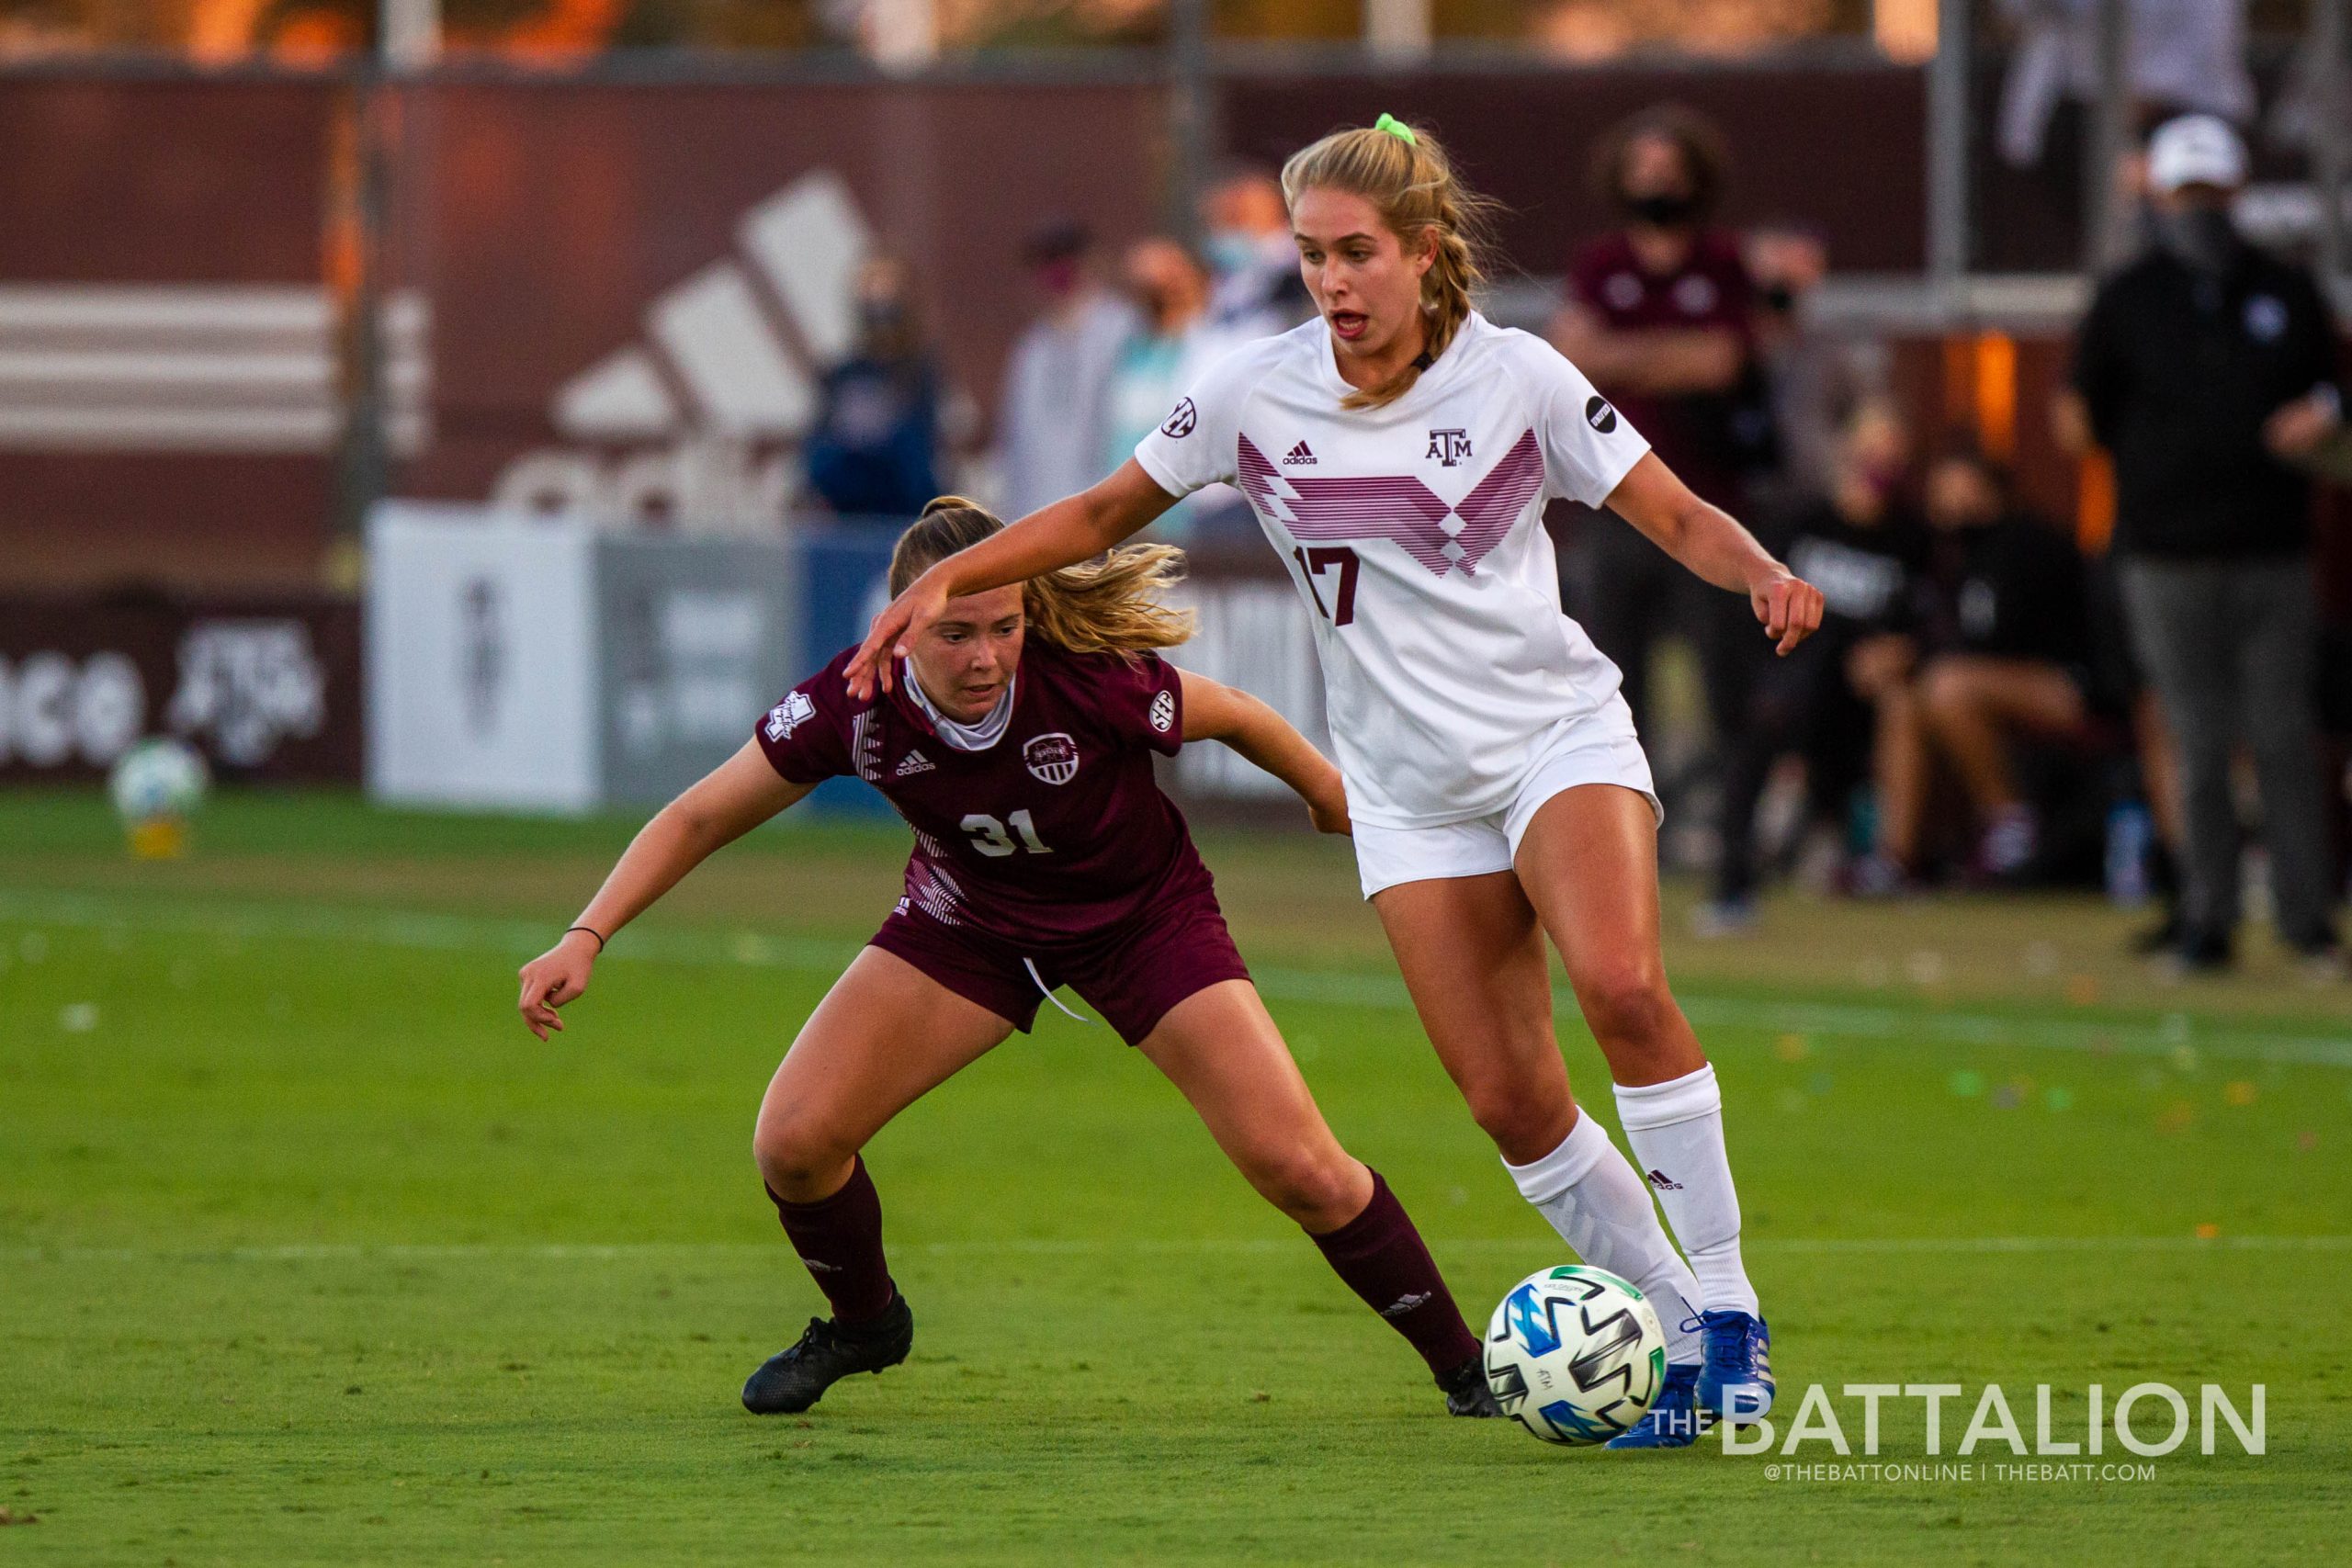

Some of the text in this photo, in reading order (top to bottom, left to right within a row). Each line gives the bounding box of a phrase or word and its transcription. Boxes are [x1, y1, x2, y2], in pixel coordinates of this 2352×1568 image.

[1283, 456, 1317, 465] adidas
[1294, 546, 1361, 627] 17
[1151, 693, 1173, 730] SEC
[896, 762, 936, 775] adidas
[960, 809, 1054, 856] 31
